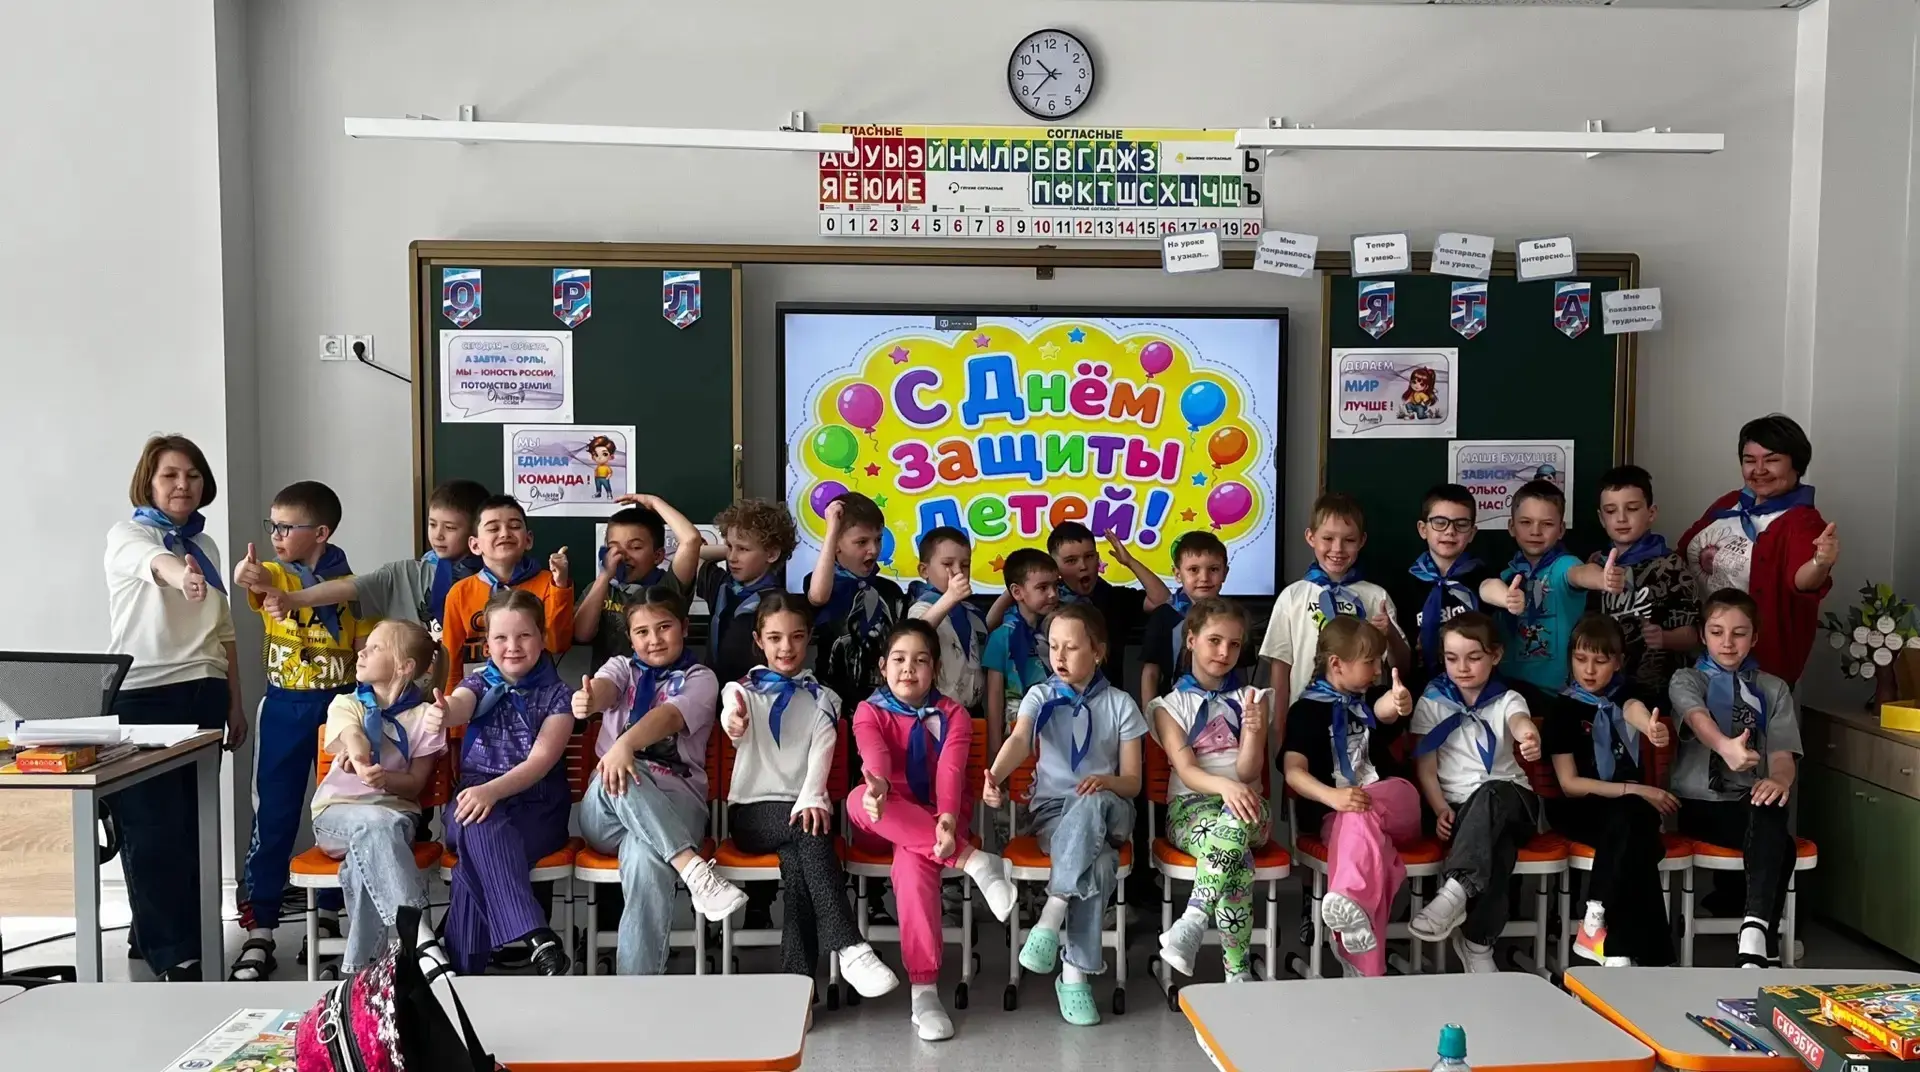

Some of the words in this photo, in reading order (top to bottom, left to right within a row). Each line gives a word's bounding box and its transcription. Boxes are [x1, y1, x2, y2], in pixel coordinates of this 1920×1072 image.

[1030, 43, 1040, 53] 11
[1044, 38, 1057, 49] 12
[1064, 42, 1069, 53] 1
[1020, 54, 1031, 65] 10
[1072, 53, 1080, 63] 2
[1017, 69, 1024, 80] 9
[1078, 68, 1086, 79] 3
[1022, 85, 1029, 96] 8
[1074, 84, 1081, 94] 4
[1034, 96, 1040, 107] 7
[1048, 100, 1055, 111] 6
[1064, 95, 1072, 106] 5
[842, 126, 903, 136] ГЛАСНЫЕ
[1047, 129, 1123, 139] СОГЛАСНЫЕ
[821, 152, 838, 167] А
[843, 147, 860, 167] О
[864, 145, 881, 168] У
[885, 145, 902, 168] Ы
[907, 146, 923, 168] Э
[929, 140, 945, 169] Й
[950, 148, 966, 170] Н
[970, 148, 988, 170] М
[991, 148, 1009, 170] Л
[1013, 148, 1029, 170] Р
[1035, 148, 1051, 171] Б
[1056, 148, 1072, 171] В
[1077, 148, 1092, 171] Г
[1096, 148, 1115, 172] Д
[1116, 148, 1137, 171] Ж
[1140, 148, 1156, 171] З
[1246, 150, 1260, 172] Ь
[821, 178, 838, 200] Я
[844, 172, 860, 200] Ё
[863, 178, 883, 200] Ю
[886, 178, 903, 200] И
[907, 179, 922, 201] Е
[1035, 182, 1050, 203] П
[1055, 181, 1073, 203] Ф
[1077, 182, 1093, 204] К
[1098, 182, 1114, 204] Т
[1117, 182, 1136, 204] Ш
[1139, 183, 1154, 205] С
[1160, 183, 1177, 204] Х
[1181, 183, 1198, 206] Ц
[1202, 184, 1218, 205] Ч
[1222, 184, 1241, 207] Щ
[1243, 183, 1261, 205] Ъ
[827, 218, 835, 231] 0
[849, 218, 855, 231] 1
[869, 219, 878, 231] 2
[891, 219, 899, 232] 3
[911, 219, 920, 232] 4
[933, 219, 941, 232] 5
[953, 219, 962, 232] 6
[975, 220, 983, 232] 7
[996, 220, 1005, 232] 8
[1017, 220, 1026, 233] 9
[1034, 220, 1050, 233] 10
[1056, 221, 1071, 233] 11
[1076, 221, 1092, 233] 12
[1097, 221, 1114, 234] 13
[1118, 221, 1134, 234] 14
[1139, 222, 1155, 234] 15
[1160, 222, 1177, 234] 16
[1181, 222, 1197, 232] 17
[1223, 223, 1238, 235] 19
[1243, 223, 1260, 235] 20
[1168, 240, 1179, 249] На
[1181, 238, 1205, 249] уроке
[1366, 241, 1396, 251] Теперь
[1461, 237, 1468, 245] Я
[1533, 241, 1556, 250] Было
[1260, 246, 1312, 260] понравилось
[1439, 248, 1487, 259] постарался
[449, 280, 476, 311] О
[562, 281, 586, 310] Р
[668, 283, 696, 312] Л
[1366, 293, 1389, 322] Я
[1457, 294, 1482, 322] Т
[1559, 294, 1585, 322] А
[1608, 304, 1656, 314] показалось
[461, 342, 502, 351] СЕГОДНЯ
[516, 356, 546, 364] ОРЛЫ,
[1344, 361, 1394, 371] ДЕЛАЕМ
[519, 369, 556, 377] РОССИИ,
[520, 382, 552, 390] ЗЕМЛИ!
[894, 369, 948, 426] С
[962, 355, 1161, 426] Днём
[1345, 380, 1379, 392] МИР
[1344, 401, 1387, 411] ЛУЧШЕ
[518, 438, 540, 447] МЫ
[518, 456, 569, 468] ЕДИНАЯ
[892, 433, 1182, 489] защиты
[1462, 453, 1497, 463] НАШЕ
[1501, 452, 1557, 464] БУДУЩЕЕ
[1461, 469, 1516, 480] ЗАВИСИТ
[518, 475, 584, 486] КОМАНДА
[1466, 486, 1507, 495] ОЛЬКО
[1478, 501, 1503, 509] НАС!
[916, 486, 1170, 548] детей!
[1776, 1015, 1820, 1062] СКРЭБУС
